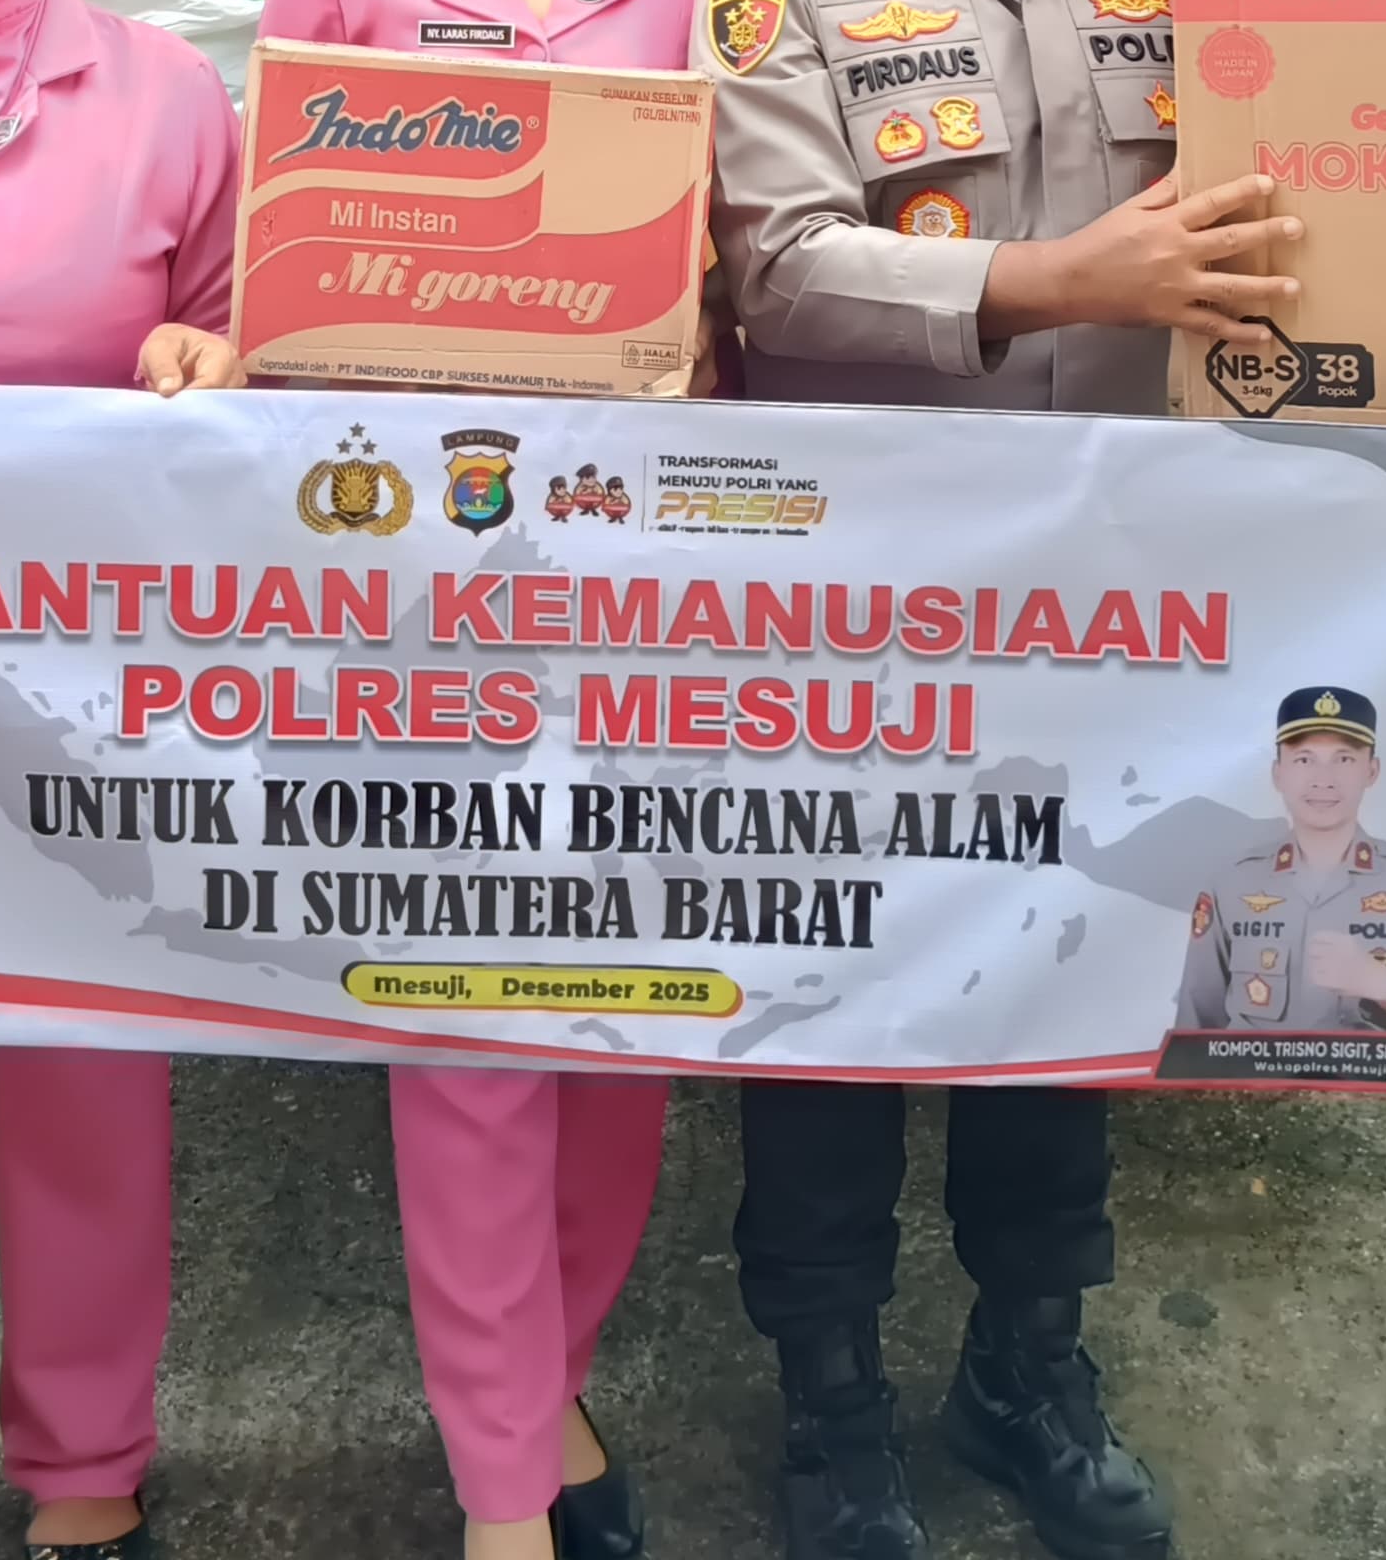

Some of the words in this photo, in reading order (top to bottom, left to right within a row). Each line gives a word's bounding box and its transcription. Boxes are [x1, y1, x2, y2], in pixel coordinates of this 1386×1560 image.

[469, 29, 505, 41] FIRDAUS
[1089, 32, 1174, 65] POL
[846, 45, 981, 98] FIRDAUS
[600, 88, 651, 103] GUNAKAN
[633, 106, 702, 127] (TGL/BLN/THN)
[329, 200, 363, 228] Mi
[370, 203, 458, 234] Instan
[318, 251, 416, 297] Mi
[410, 269, 617, 325] goreng
[337, 363, 353, 375] PT
[421, 369, 444, 380] CBP
[447, 369, 490, 383] SUKSES
[546, 377, 566, 389] Tbk
[1215, 353, 1295, 382] NB-S
[1316, 353, 1360, 384] 38
[1318, 385, 1358, 398] Popok
[447, 432, 514, 447] LAMPUNG
[658, 455, 778, 471] TRANSFORMASI
[658, 475, 722, 488] MENUJU
[725, 477, 771, 490] POLRI
[775, 479, 818, 492] YANG
[655, 491, 828, 524] PRESISI
[429, 570, 1229, 664] KEMANUSIAAN
[119, 662, 541, 742] POLRES
[575, 671, 977, 755] MESUJI
[24, 773, 239, 845] UNTUK
[261, 779, 546, 851] KORBAN
[566, 783, 862, 856] BENCANA
[883, 791, 1066, 866] ALAM
[202, 868, 279, 933] DI
[303, 871, 639, 939] SUMATERA
[660, 877, 884, 948] BARAT
[1231, 921, 1286, 939] SIGIT
[501, 977, 635, 1000] Desember
[648, 981, 710, 1002] 2025
[1208, 1040, 1271, 1058] KOMPOL
[1274, 1041, 1327, 1058] TRISNO
[1331, 1042, 1372, 1061] SIGIT,
[1254, 1061, 1338, 1074] Wakapolres
